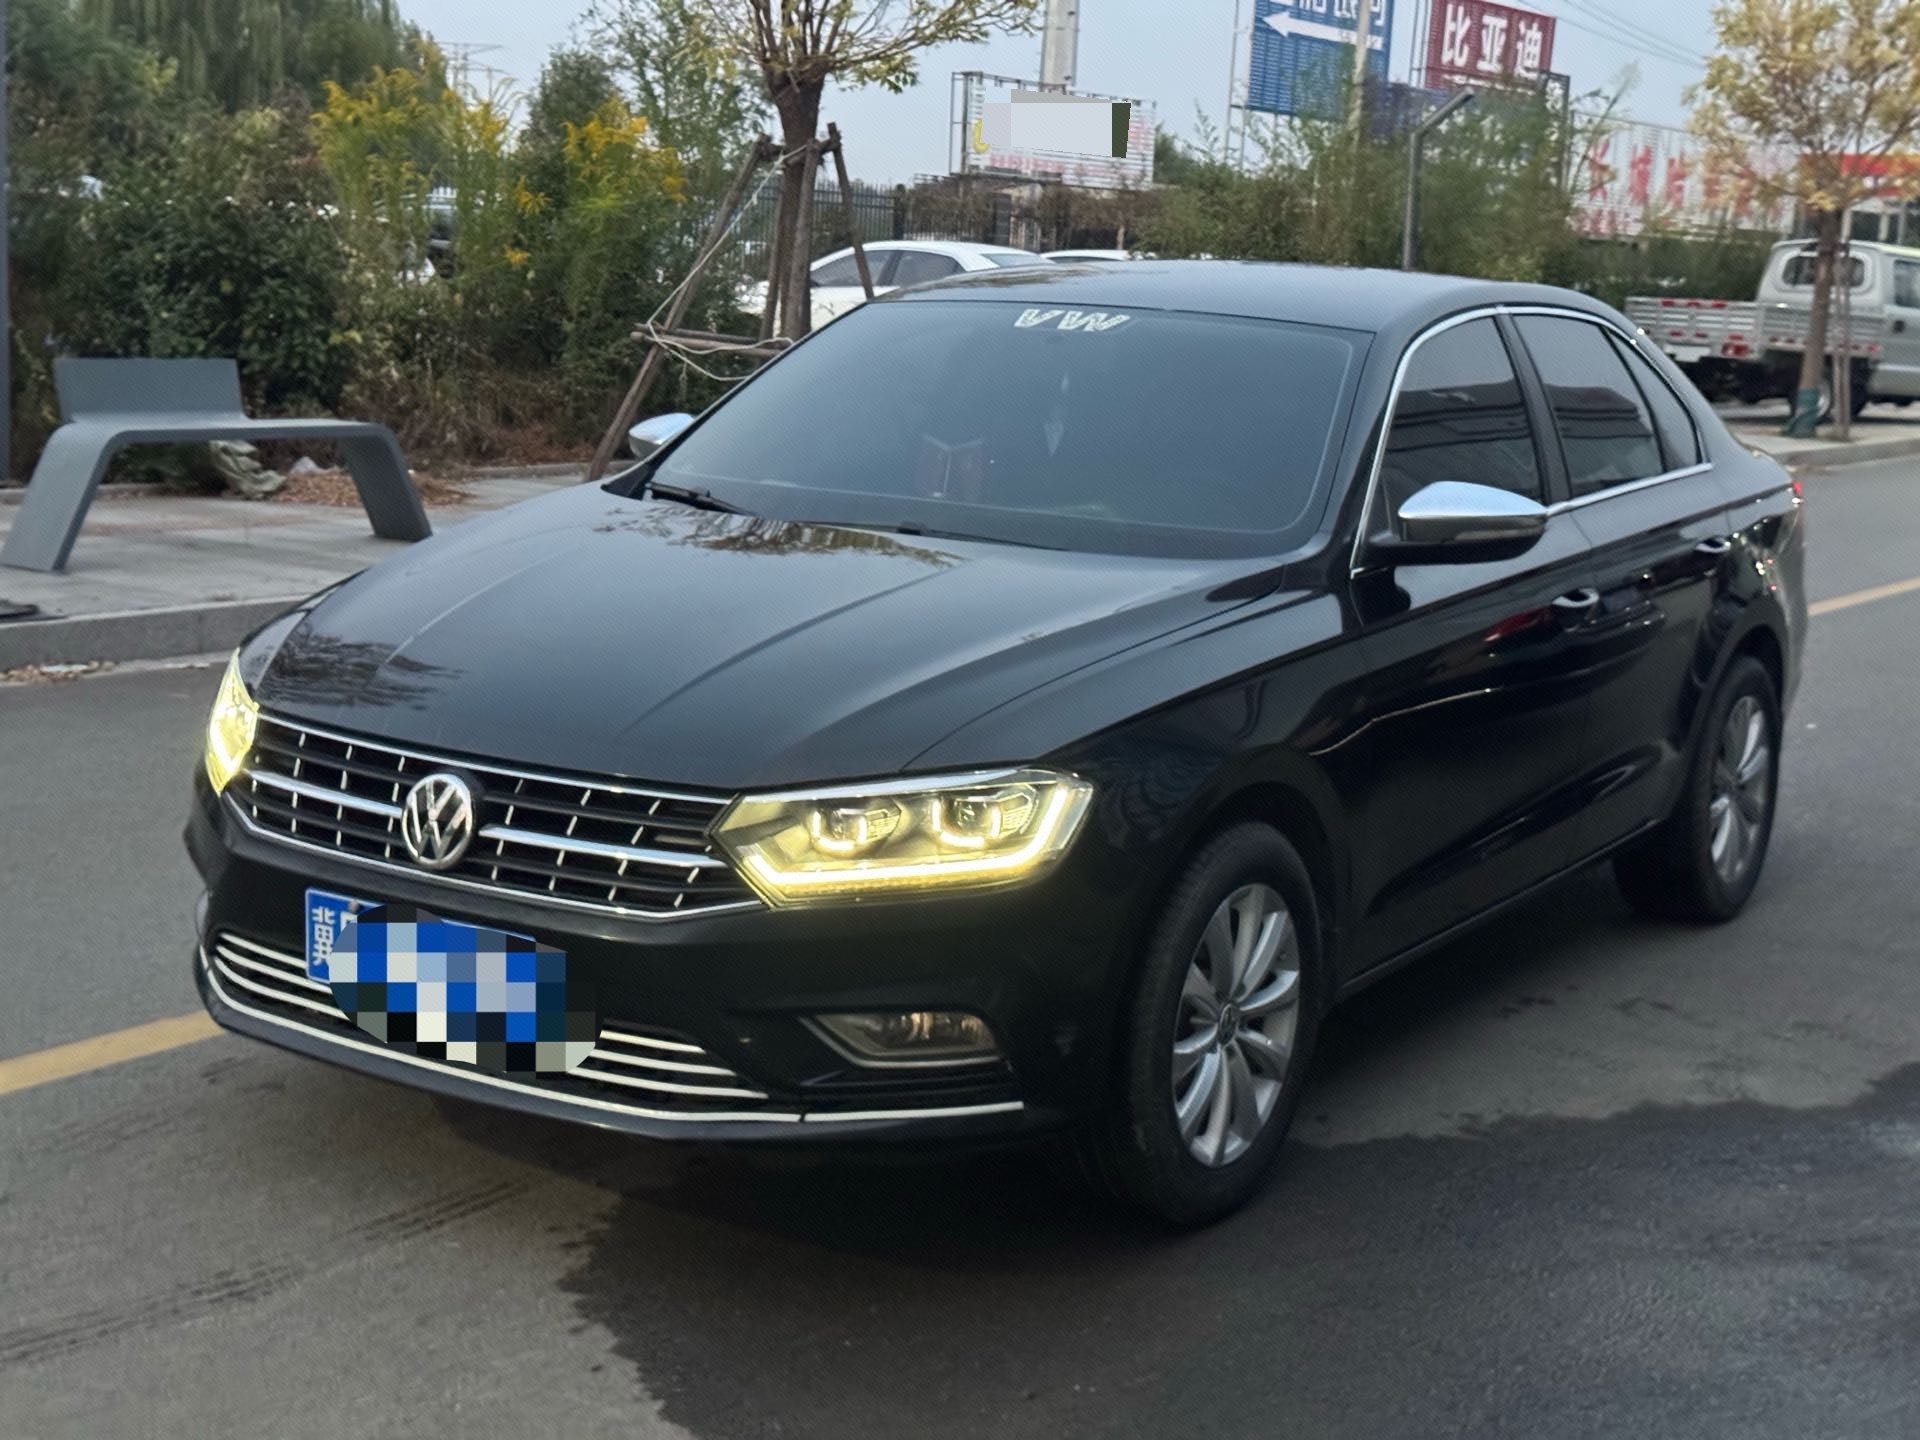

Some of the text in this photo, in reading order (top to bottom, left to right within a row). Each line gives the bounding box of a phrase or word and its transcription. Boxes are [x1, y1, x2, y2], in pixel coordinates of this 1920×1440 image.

[1441, 3, 1542, 80] 比亚迪
[1013, 308, 1131, 332] VW
